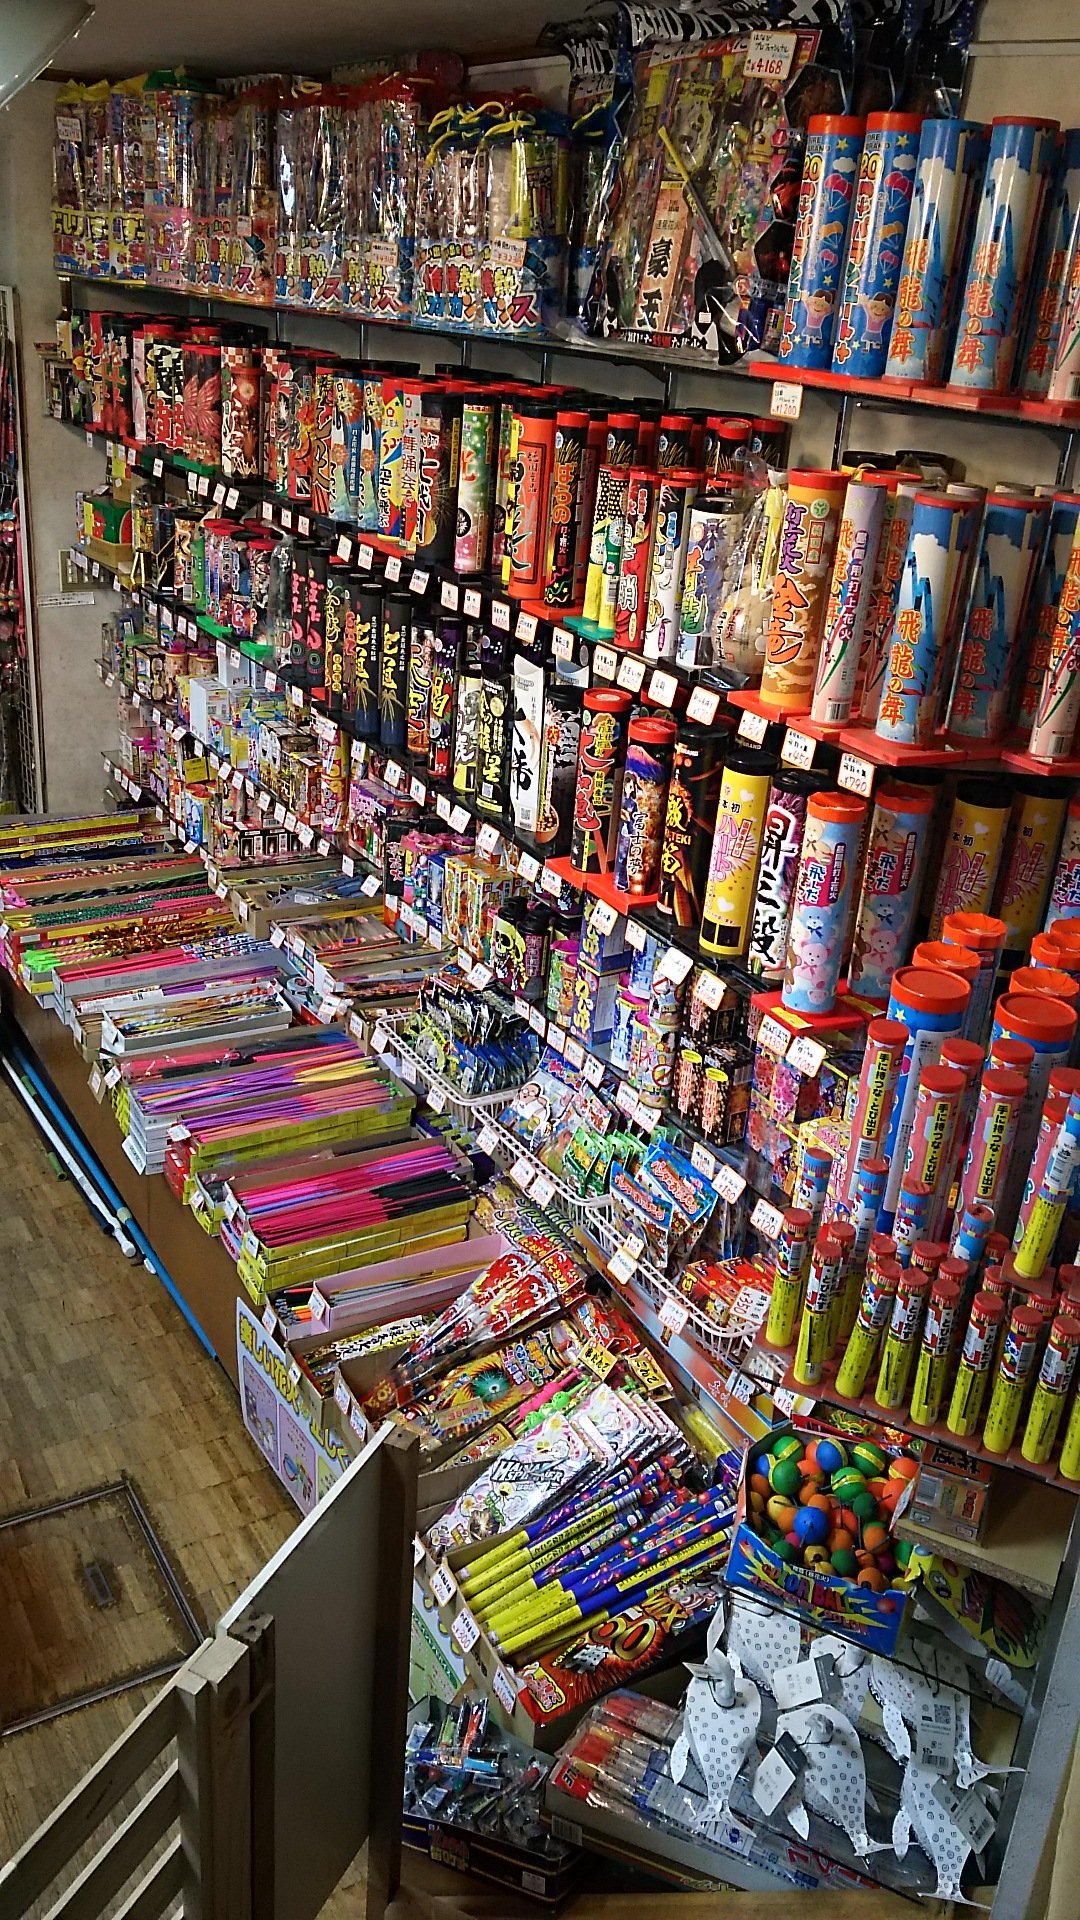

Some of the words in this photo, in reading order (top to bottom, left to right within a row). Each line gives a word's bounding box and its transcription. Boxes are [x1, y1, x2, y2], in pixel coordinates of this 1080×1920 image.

[890, 238, 929, 363] 飛龍の舞
[955, 240, 1002, 374] 飛龍の舞
[778, 502, 808, 575] 打上花火
[879, 607, 922, 728] 飛龍の舞
[952, 606, 995, 722] 飛龍の舞
[865, 1053, 889, 1136] 手に持つな・とび出す
[980, 1104, 1008, 1195] 手に持つな・とび出す
